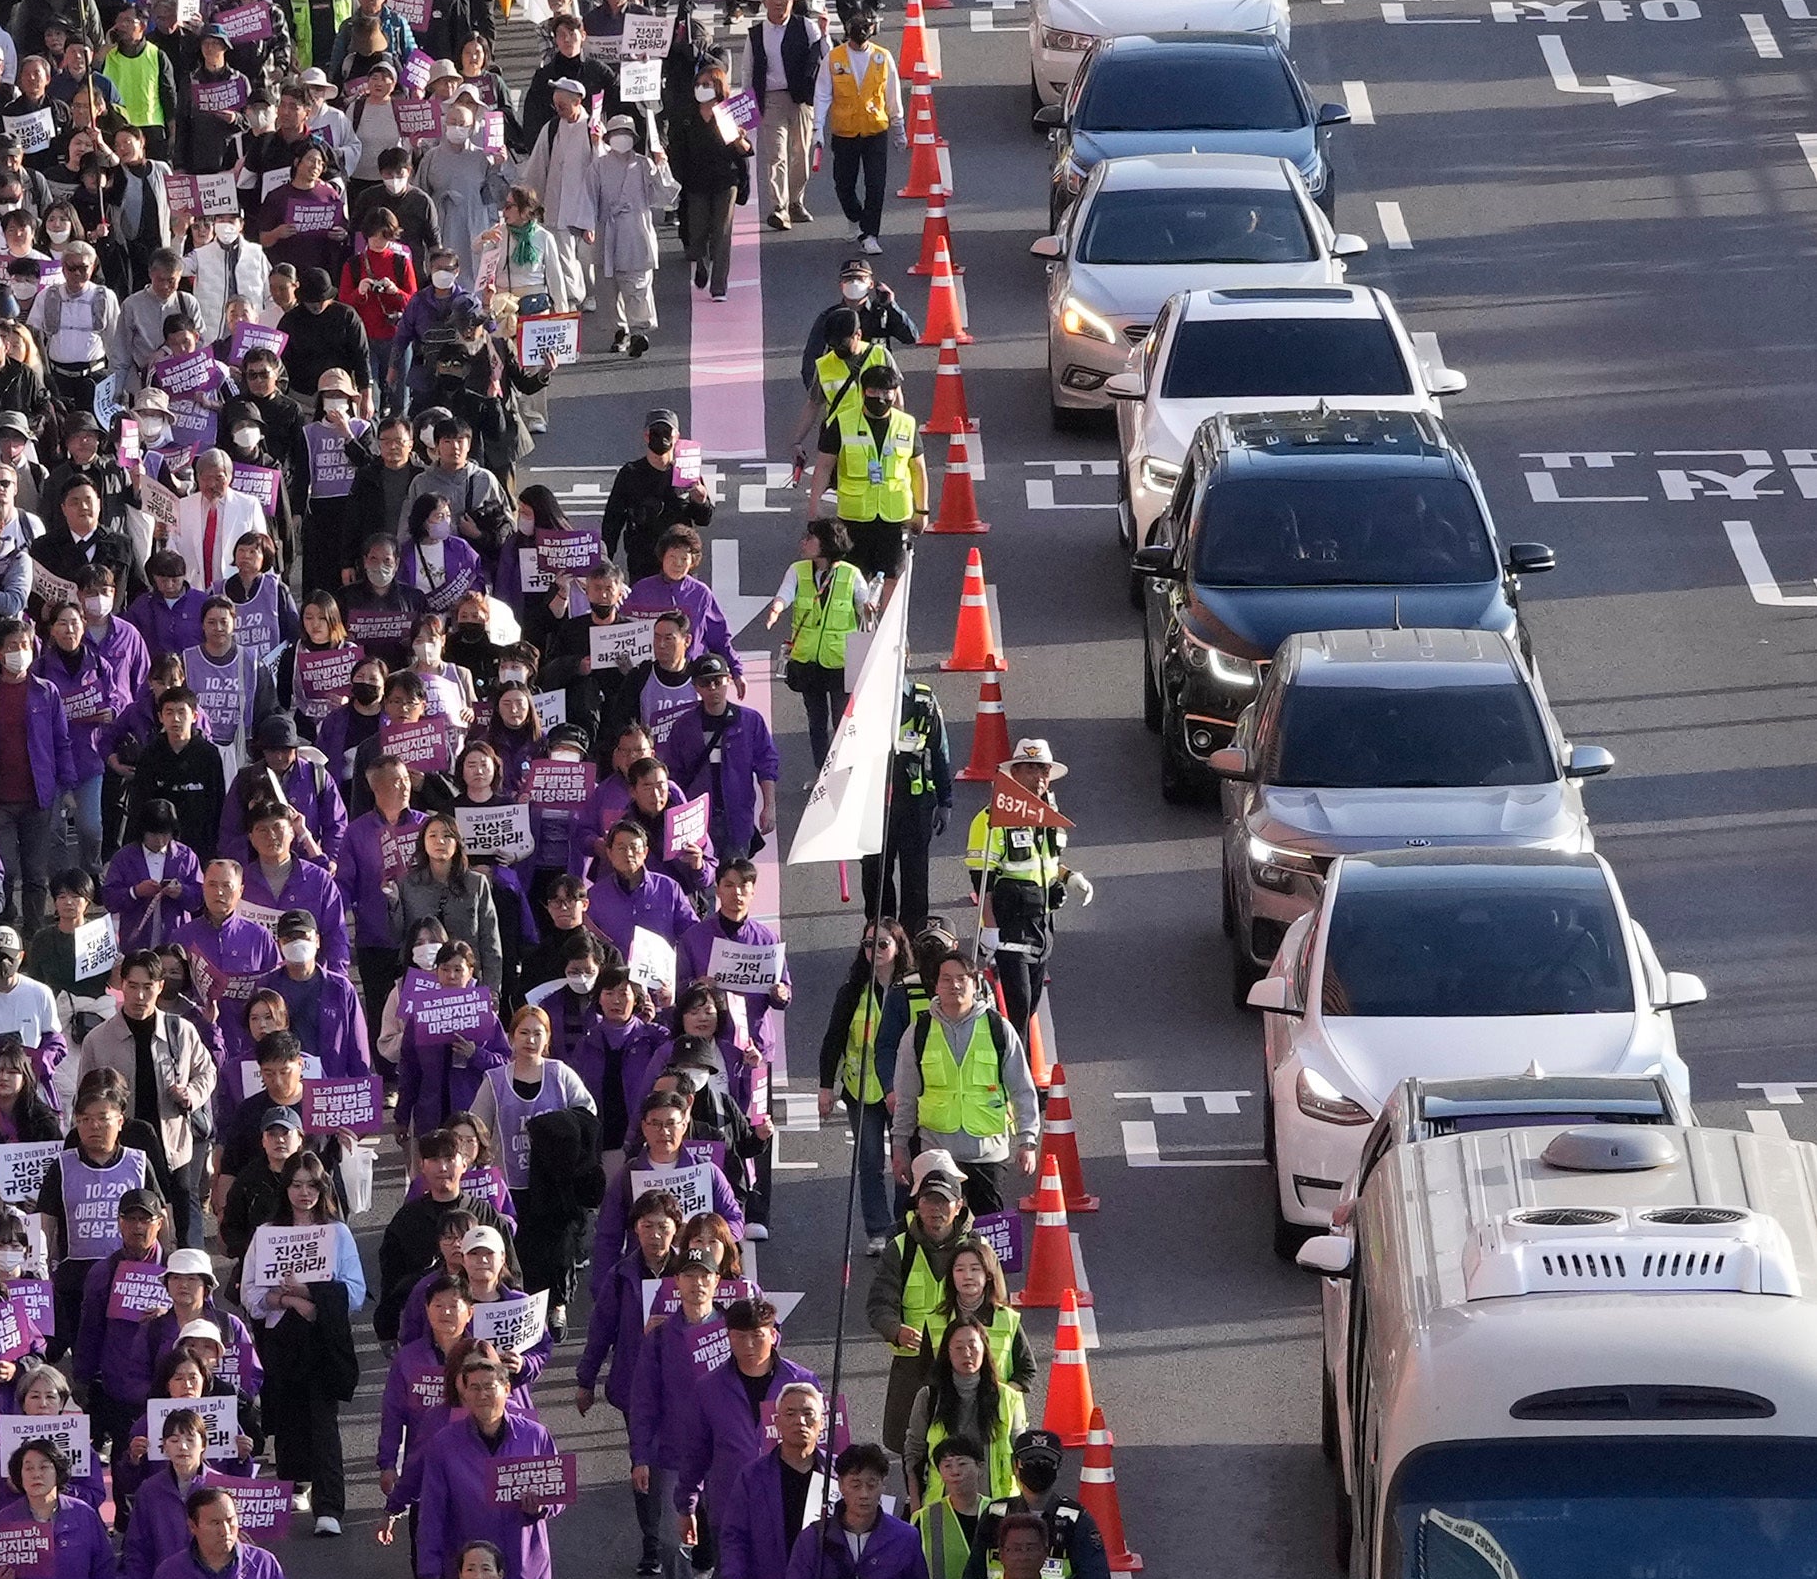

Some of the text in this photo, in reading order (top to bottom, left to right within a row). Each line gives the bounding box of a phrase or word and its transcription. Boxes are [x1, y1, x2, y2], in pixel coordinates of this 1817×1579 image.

[996, 792, 1045, 824] 63기-1
[734, 961, 761, 974] 기억
[714, 971, 776, 986] 하겠습니다
[416, 1001, 489, 1023] 재발방지대책
[428, 1017, 481, 1034] 마련하라!
[312, 1091, 372, 1113] 특별법을
[310, 1108, 374, 1128] 제정하라!
[274, 1241, 319, 1262] 진상을
[264, 1256, 327, 1280] 규명하라!
